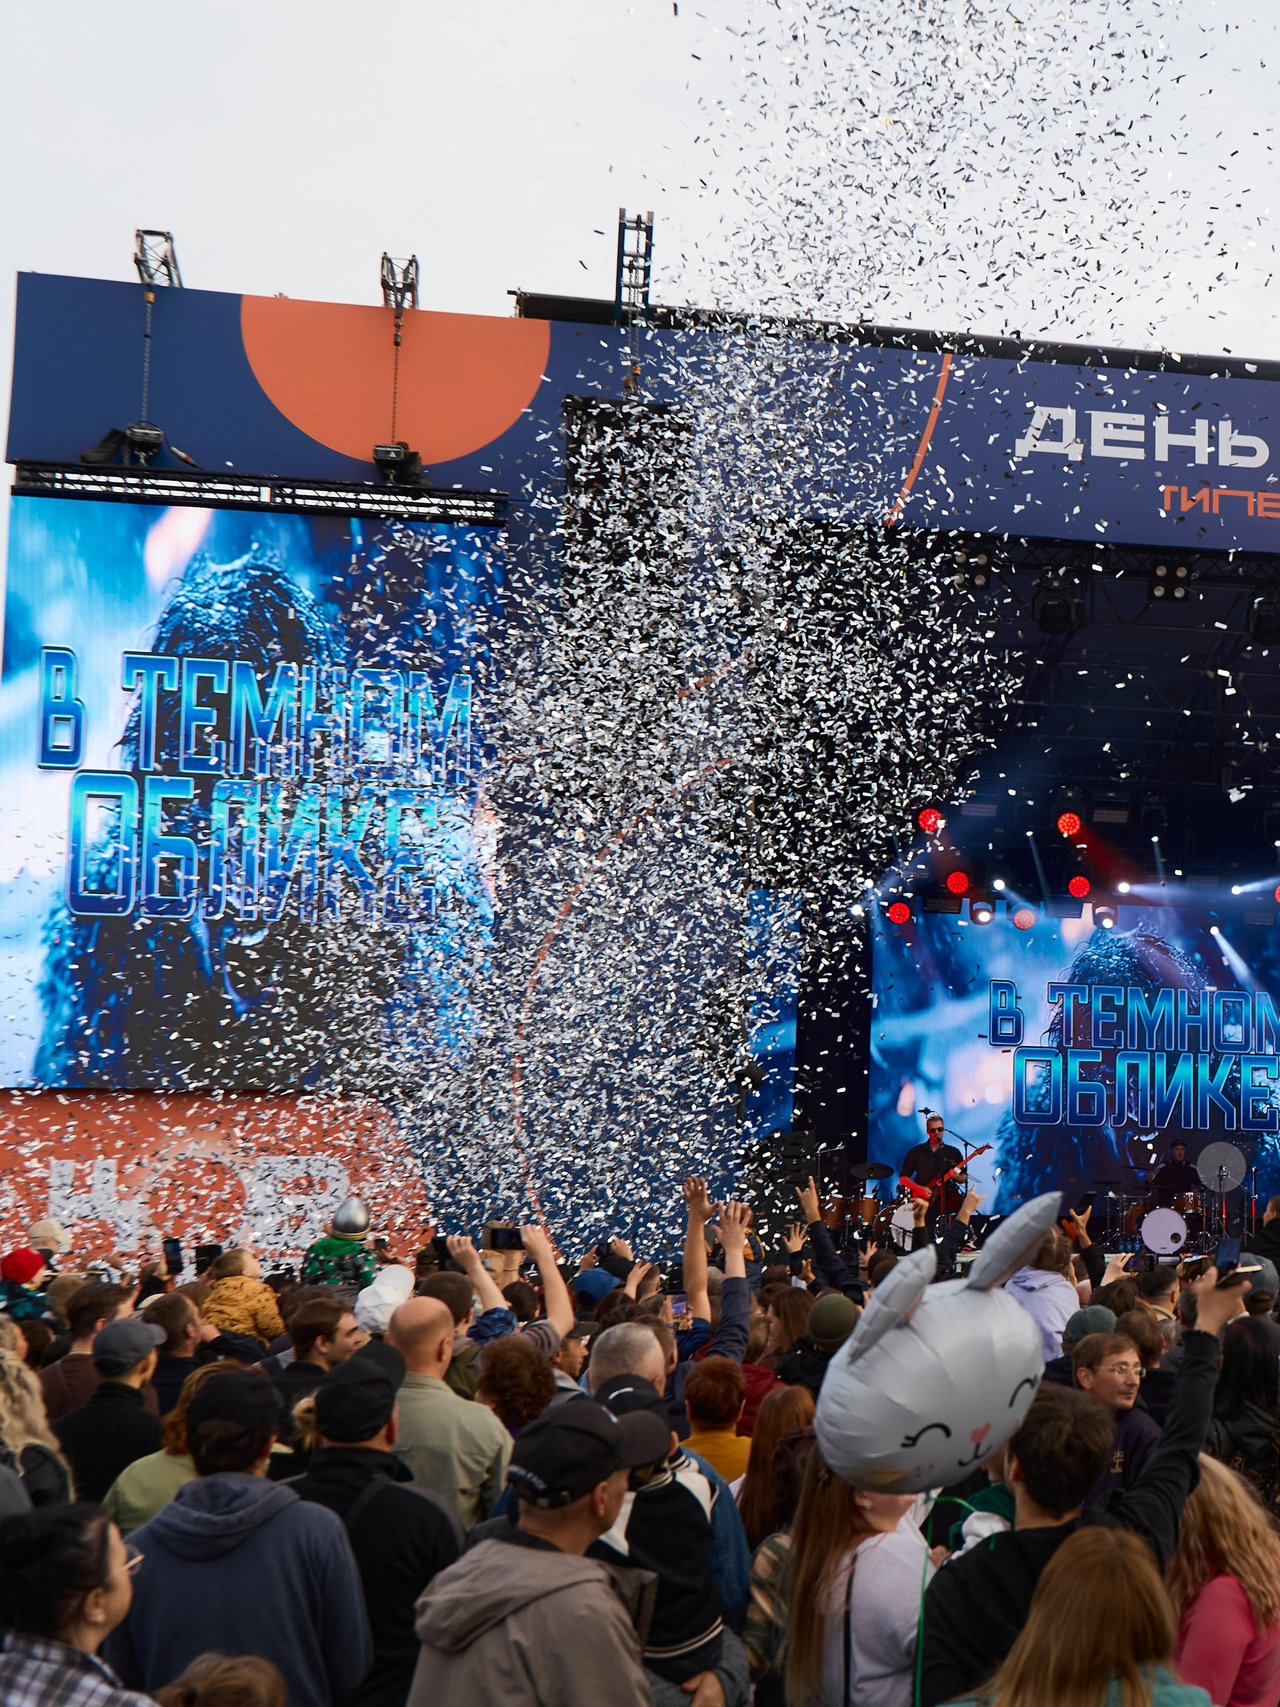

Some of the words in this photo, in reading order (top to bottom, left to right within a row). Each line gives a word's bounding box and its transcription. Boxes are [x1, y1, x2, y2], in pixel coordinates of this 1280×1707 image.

[1015, 405, 1271, 469] ДЕНЬ
[37, 646, 87, 770] В
[121, 650, 473, 787] ТЕМНОМ
[66, 769, 440, 926] ОБЛИКЕ
[989, 979, 1024, 1047] В
[1013, 1046, 1280, 1132] ОБЛИКЕ
